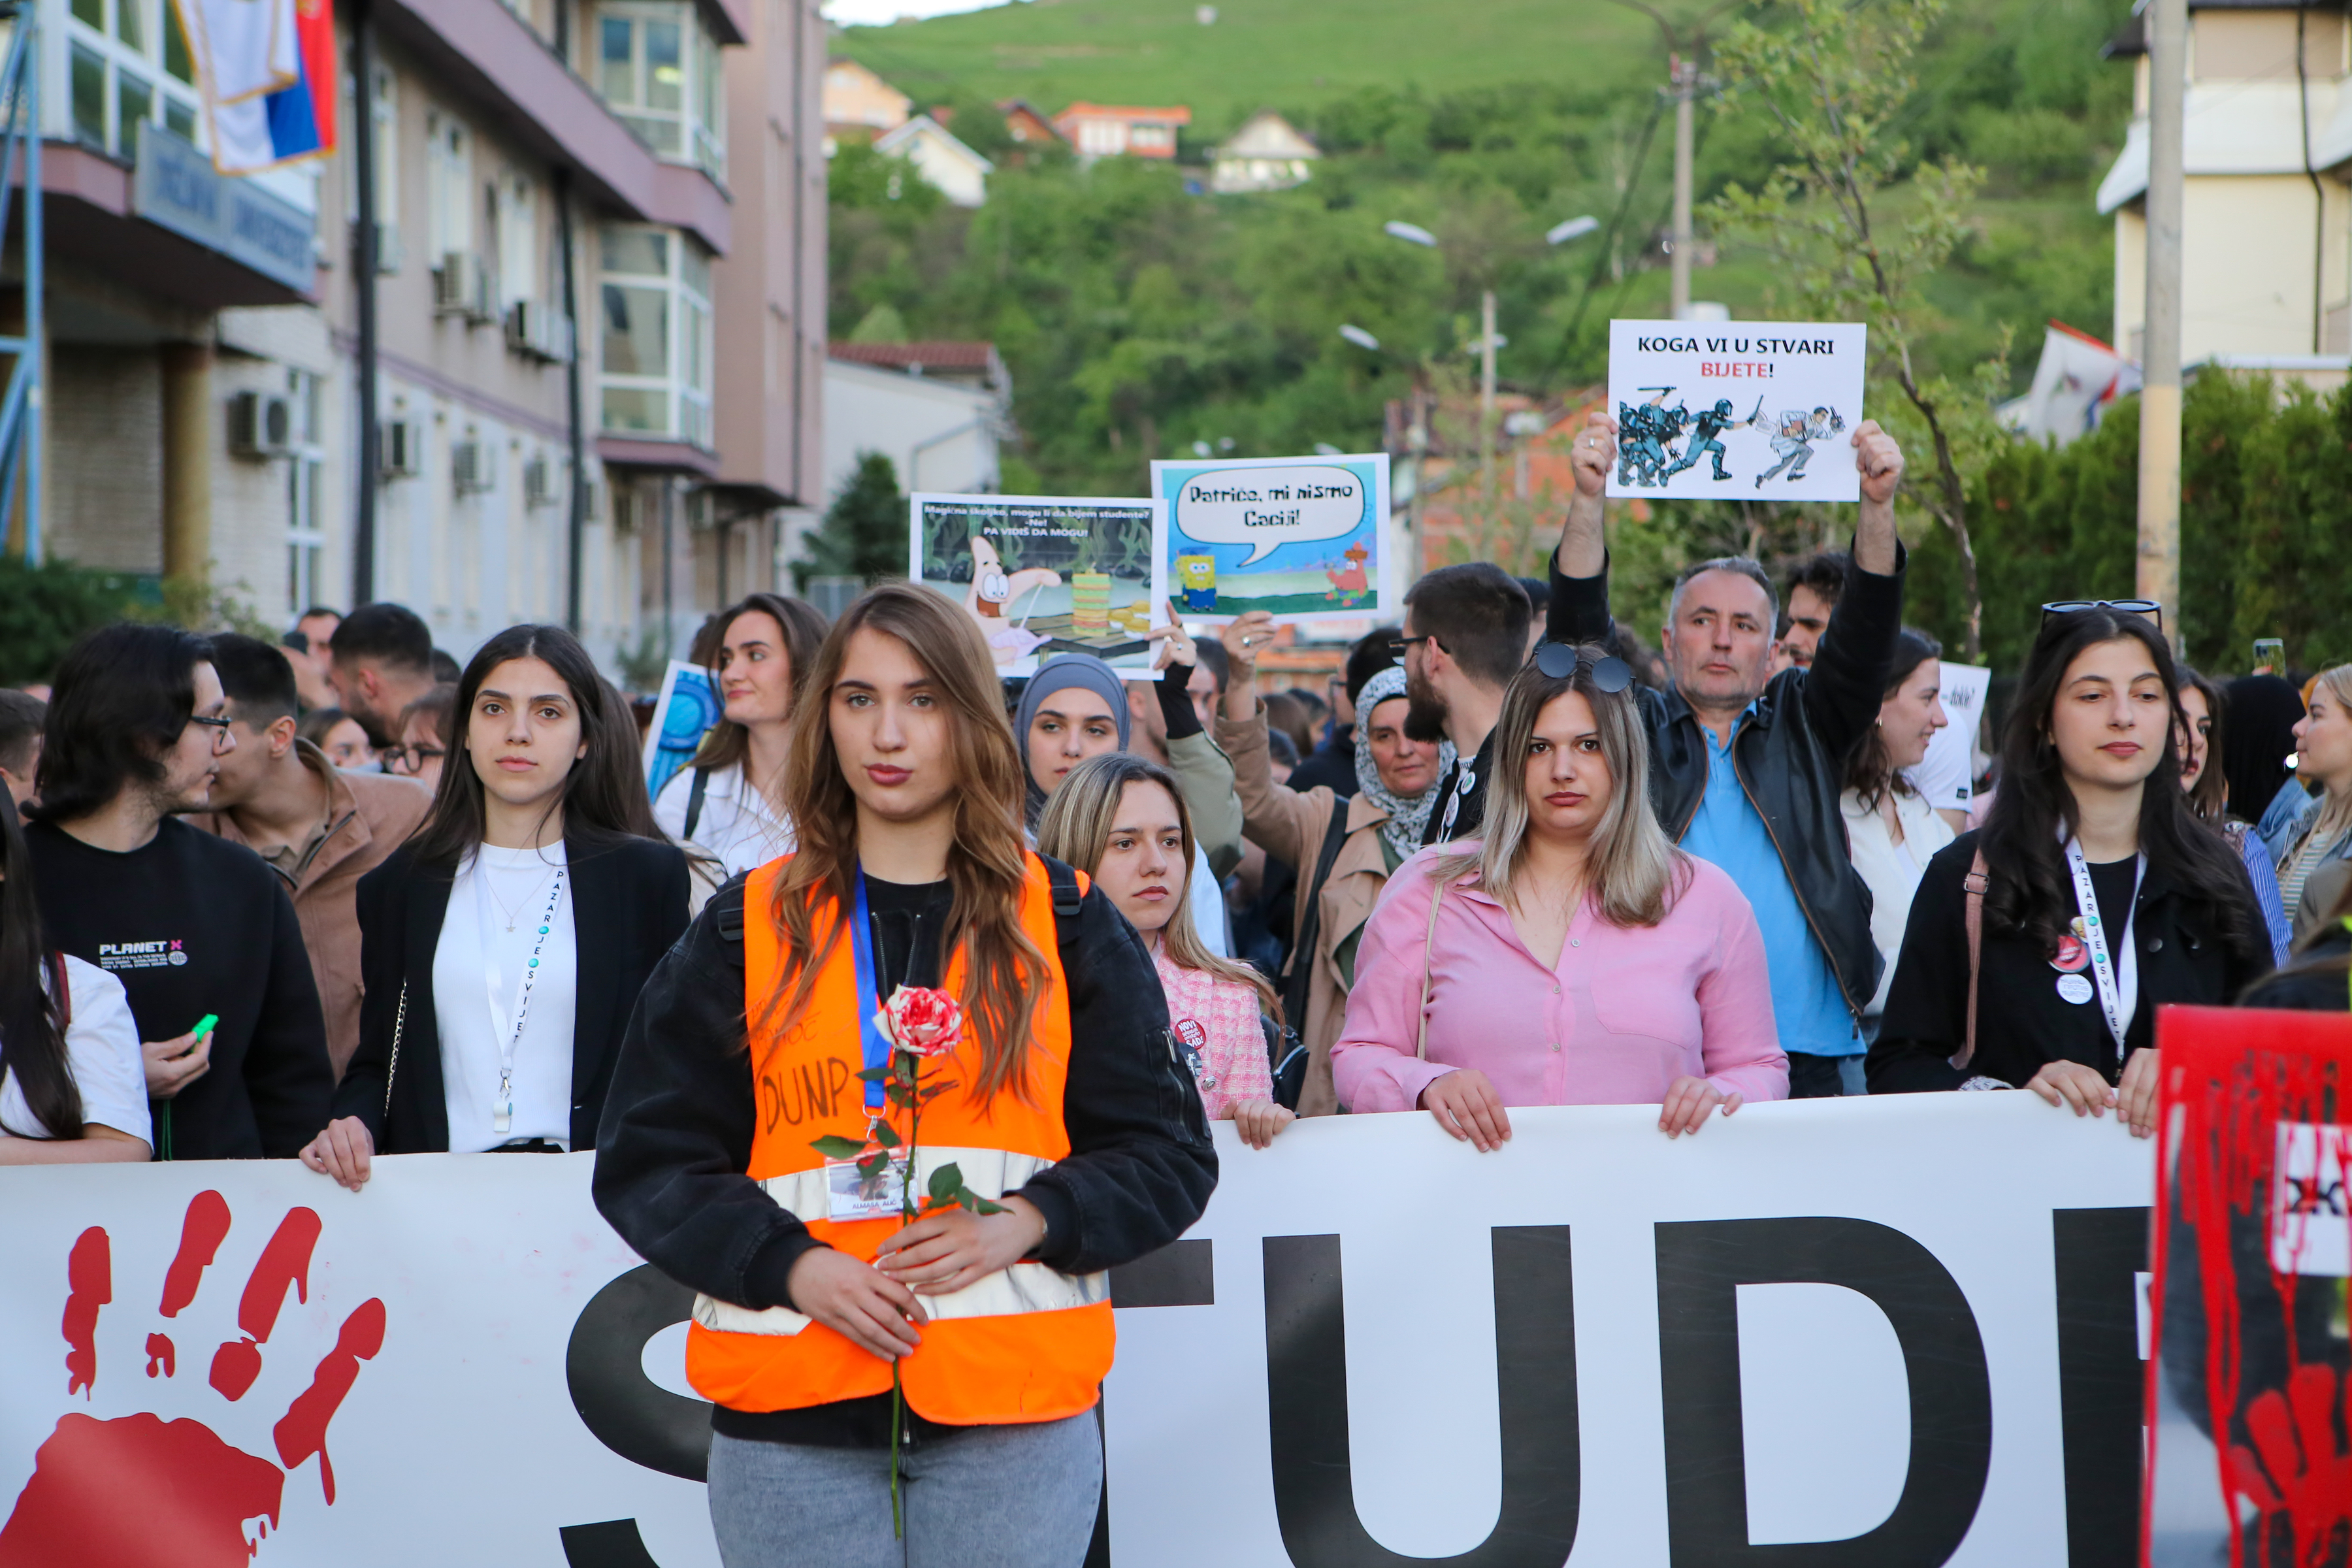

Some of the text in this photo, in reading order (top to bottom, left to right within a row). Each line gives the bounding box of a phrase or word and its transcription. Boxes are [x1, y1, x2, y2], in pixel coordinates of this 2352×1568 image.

[1638, 337, 1834, 355] KOGA VI U STVARI
[1701, 362, 1773, 377] BIJETE!
[1269, 485, 1289, 500] mi
[1297, 483, 1352, 498] nismo
[1011, 509, 1041, 517] mogu
[1068, 510, 1097, 519] bijem
[1099, 510, 1149, 519] studente?
[1001, 527, 1030, 536] VIDIŠ
[2076, 855, 2095, 912] PAZAR
[544, 871, 563, 923] PAZAR
[99, 939, 182, 955] PLANET X
[534, 936, 544, 955] JE
[1178, 1021, 1197, 1031] NOVI
[1186, 1036, 1203, 1047] SAD!
[762, 1056, 849, 1135] DUNP
